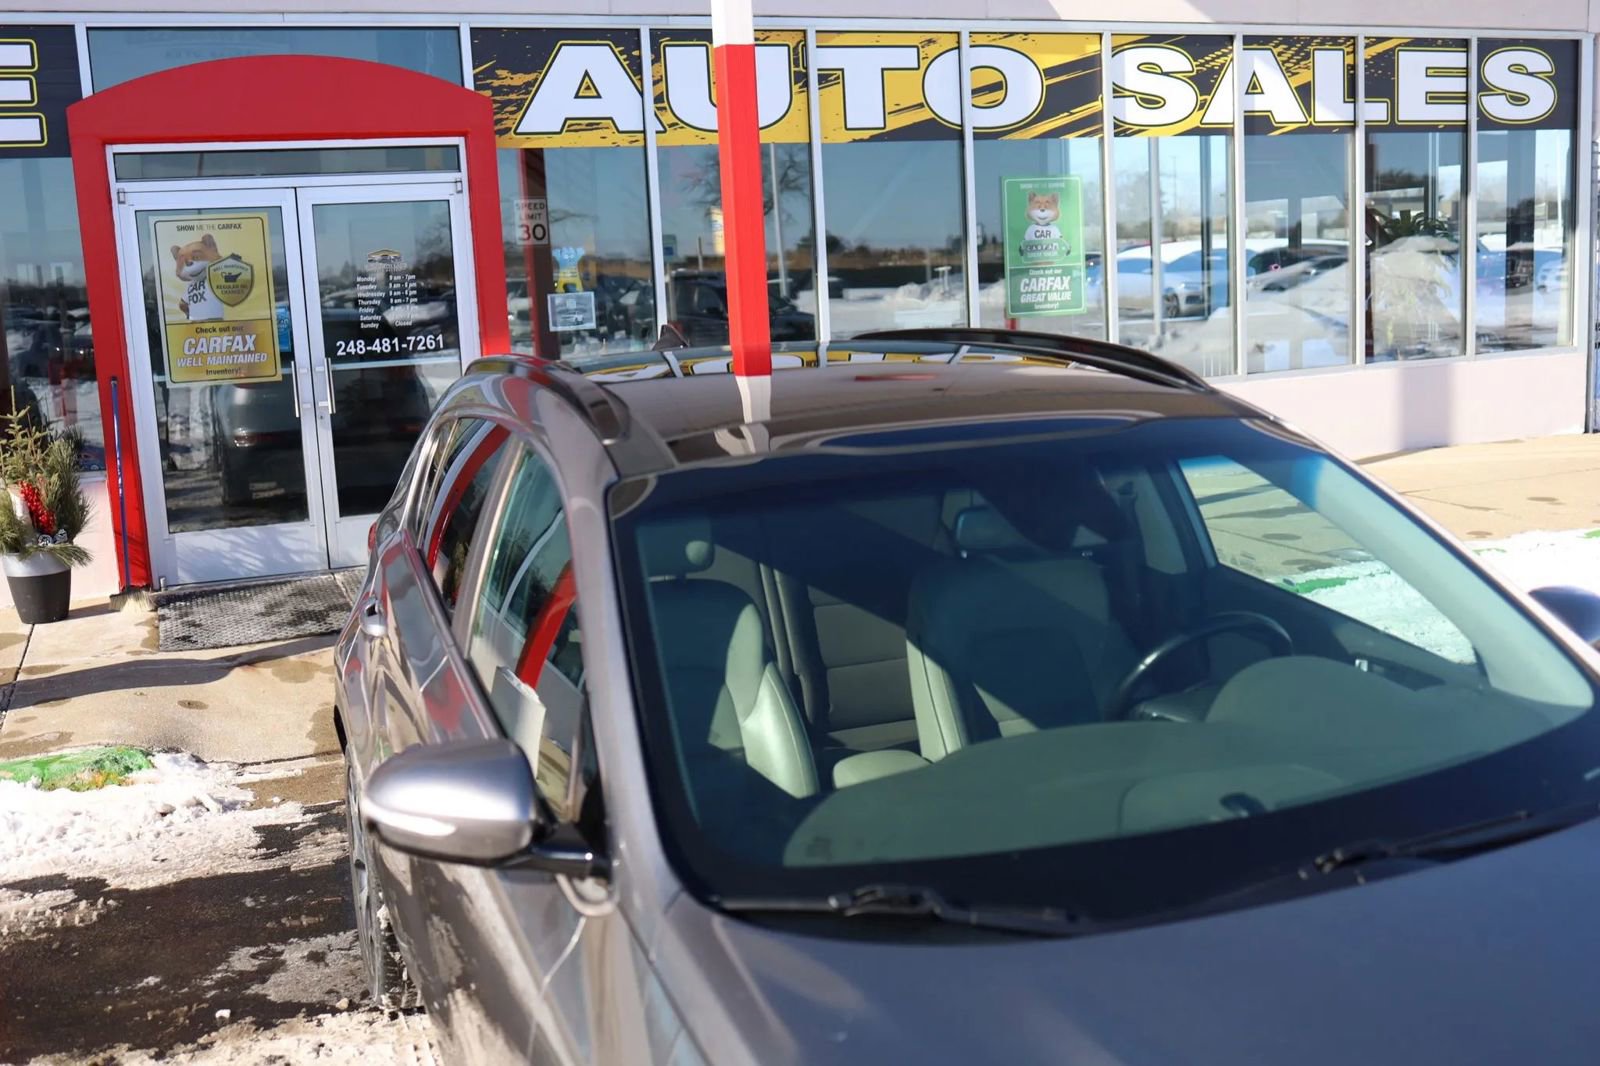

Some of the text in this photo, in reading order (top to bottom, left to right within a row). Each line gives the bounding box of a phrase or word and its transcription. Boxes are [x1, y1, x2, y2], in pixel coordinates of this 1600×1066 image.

[513, 41, 1045, 135] AUTO
[1111, 44, 1558, 127] SALES
[517, 223, 547, 241] 30
[1034, 229, 1052, 238] CAR
[187, 280, 205, 294] CAR
[1020, 275, 1071, 293] CARFAX
[188, 292, 207, 305] FOX
[1020, 290, 1072, 304] GREAT VALUE
[195, 326, 217, 334] Check
[183, 334, 257, 355] CARFAX
[336, 334, 444, 356] 248-481-7261
[176, 352, 268, 368] WELL MAINTAINED
